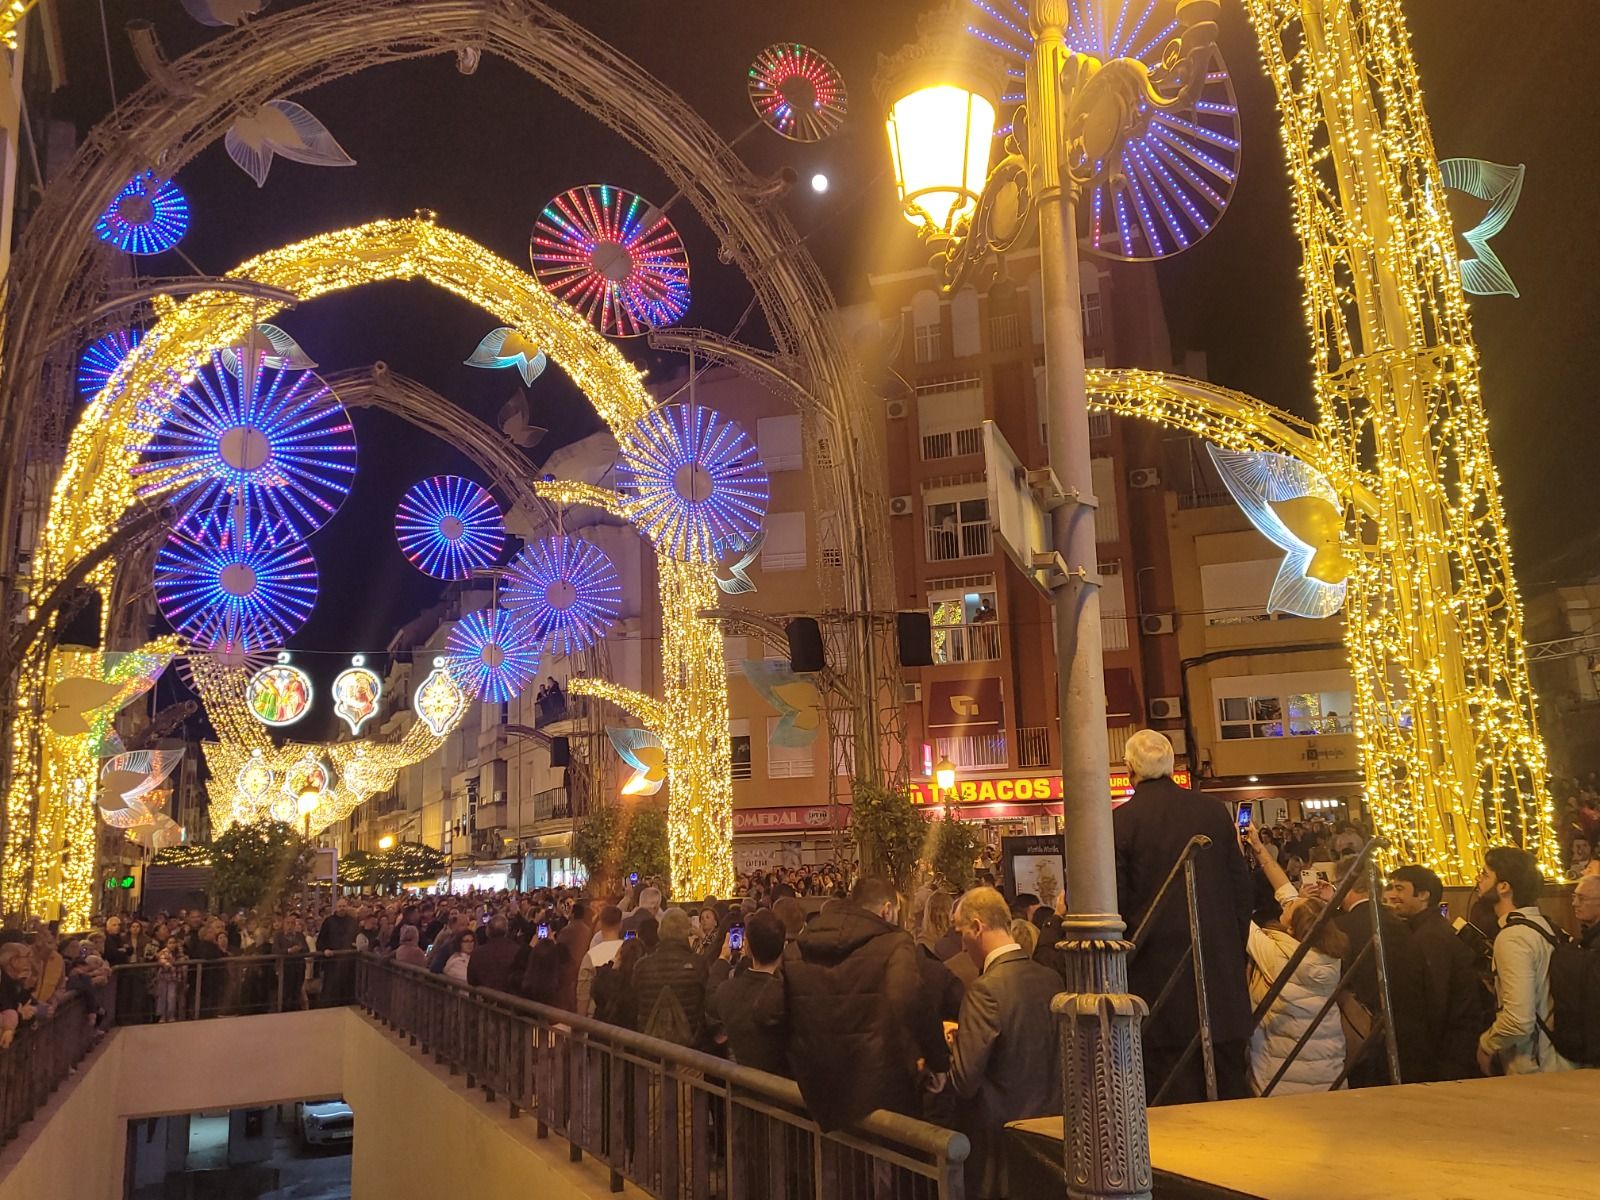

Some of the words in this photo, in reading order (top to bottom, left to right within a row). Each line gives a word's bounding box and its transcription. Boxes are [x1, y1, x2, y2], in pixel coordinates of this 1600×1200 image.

[1109, 778, 1130, 787] URO
[928, 779, 1051, 803] TABACOS
[734, 812, 801, 827] OMERAL
